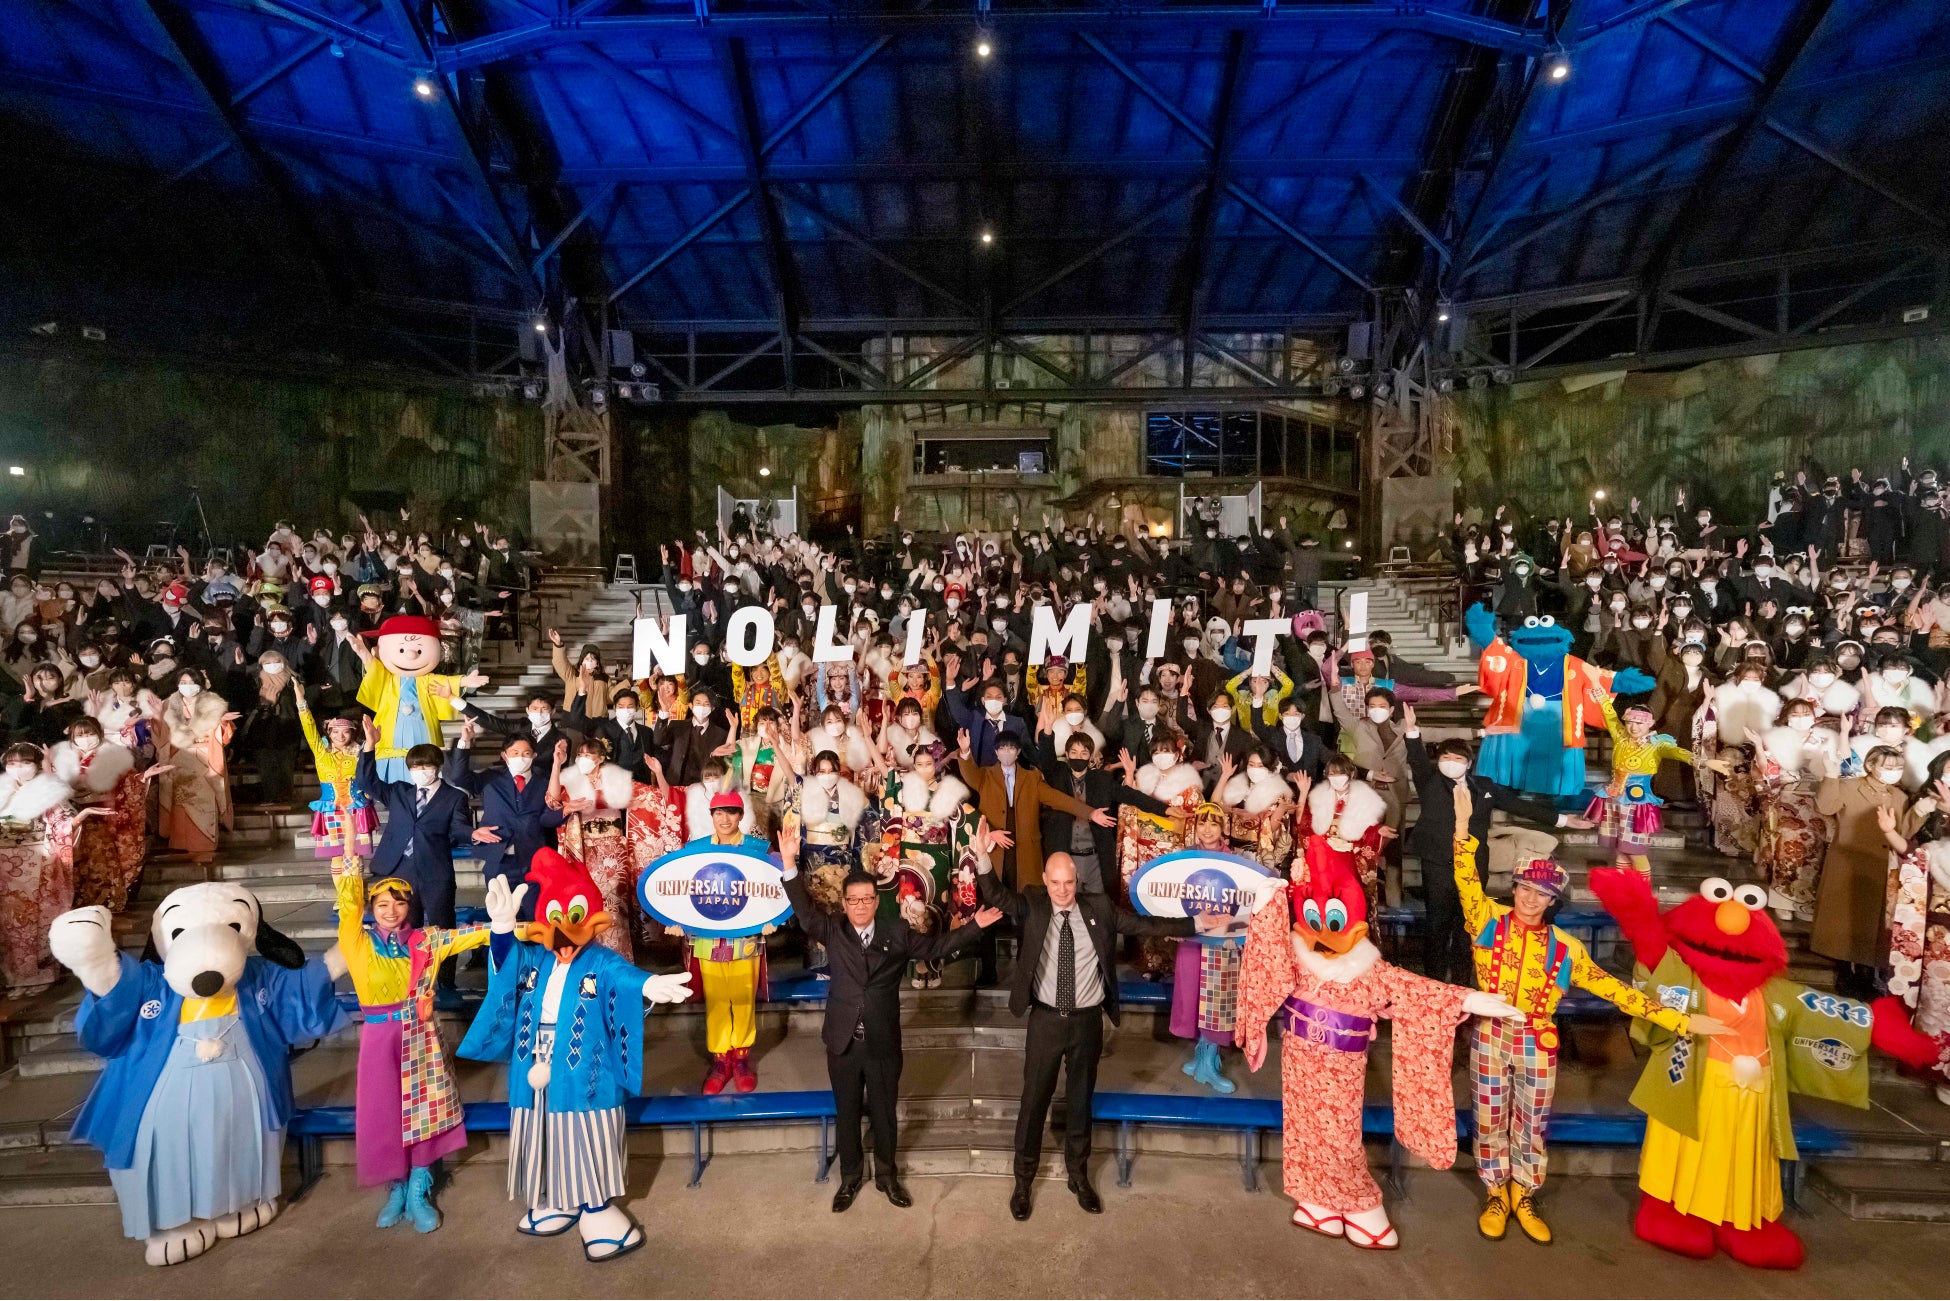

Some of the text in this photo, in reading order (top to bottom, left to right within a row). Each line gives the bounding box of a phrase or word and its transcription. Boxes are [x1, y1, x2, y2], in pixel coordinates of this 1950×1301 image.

[655, 879, 784, 899] UNIVERSAL STUDIOS
[1147, 882, 1257, 908] UNIVERSAL STUD
[697, 896, 741, 906] JAPAN
[1188, 901, 1232, 914] JAPAN
[1794, 1037, 1839, 1056] UNIVERSAL
